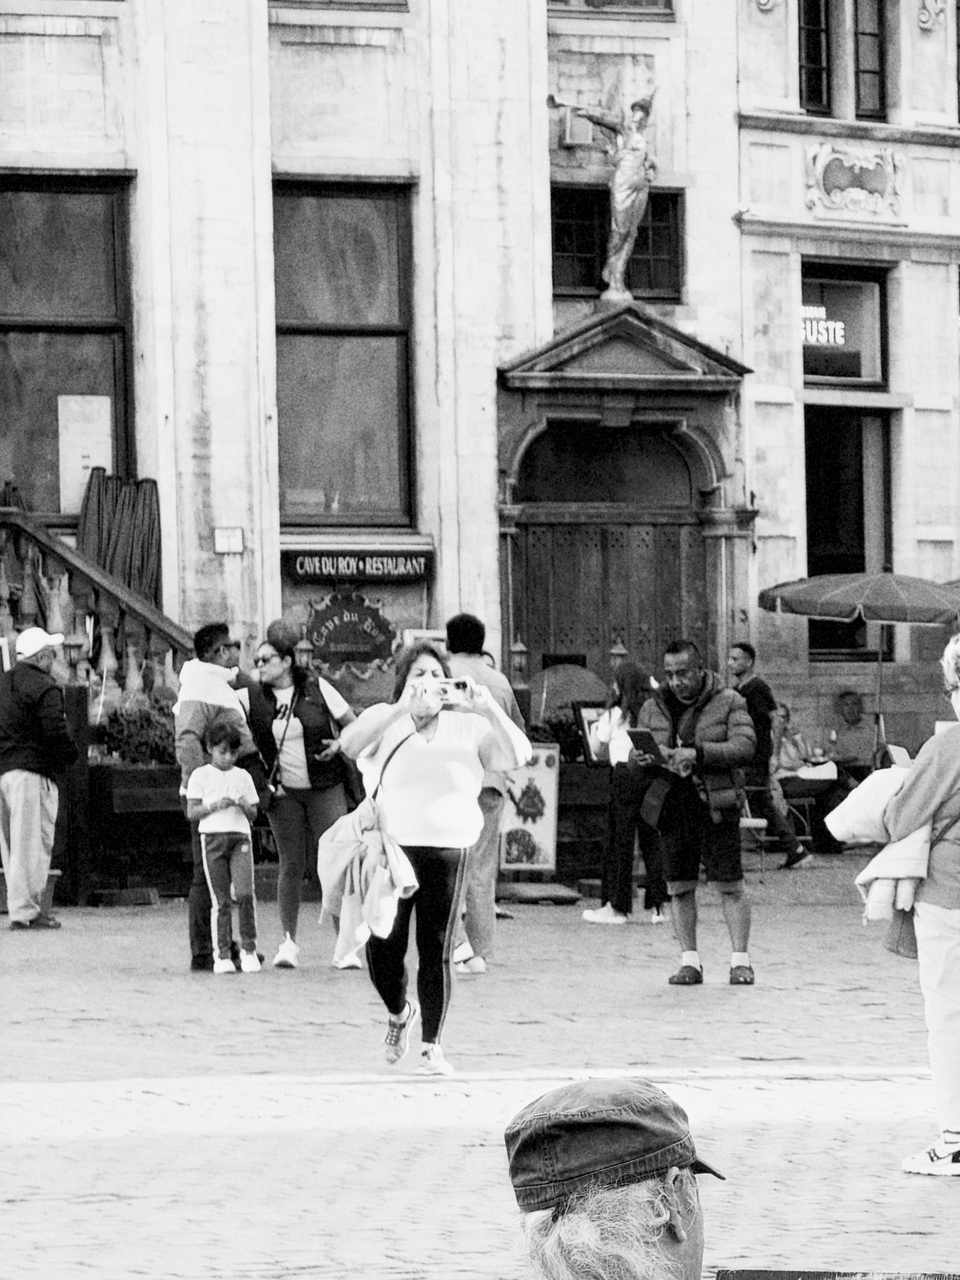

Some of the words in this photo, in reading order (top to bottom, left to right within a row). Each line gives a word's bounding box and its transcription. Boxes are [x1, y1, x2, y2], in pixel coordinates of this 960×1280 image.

[296, 556, 321, 575] CAVE
[321, 556, 337, 575] DU
[338, 556, 358, 575] ROY
[365, 556, 425, 575] RESTAURANT
